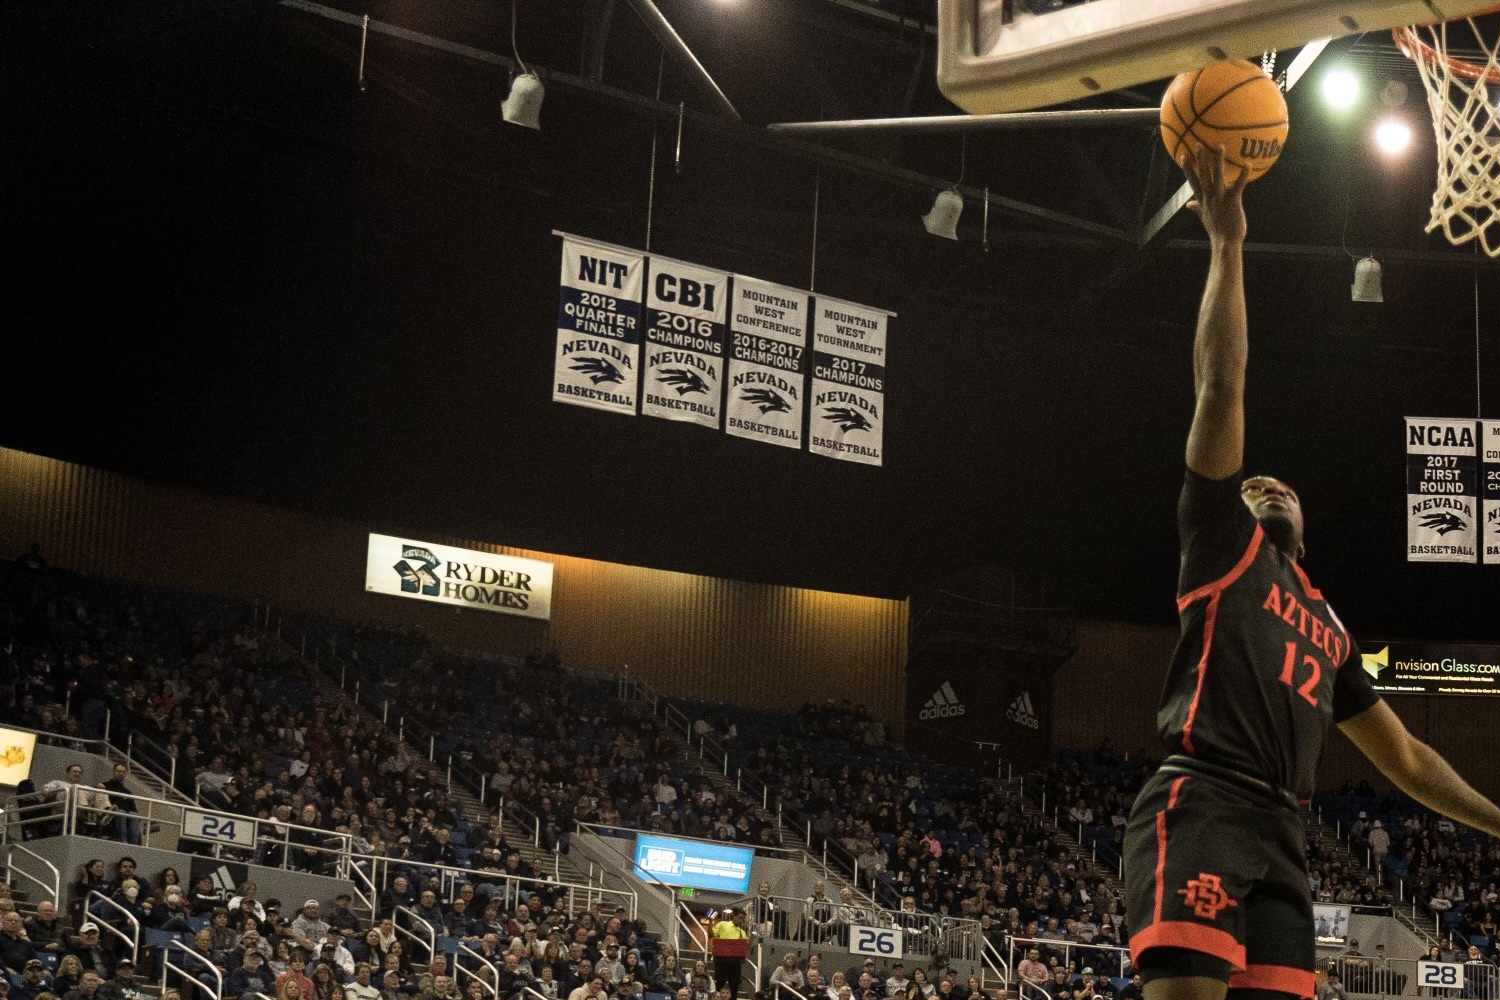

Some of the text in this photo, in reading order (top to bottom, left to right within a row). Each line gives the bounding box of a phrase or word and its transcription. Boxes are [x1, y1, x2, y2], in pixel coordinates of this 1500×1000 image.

[578, 255, 627, 288] NIT
[580, 293, 617, 310] 2012
[655, 273, 715, 312] CBI
[743, 289, 798, 310] MOUNTAIN
[564, 303, 636, 329] QUARTER
[754, 304, 785, 319] WEST
[825, 310, 878, 330] MOUNTAIN
[575, 319, 624, 338] FINALS
[657, 312, 712, 336] 2016
[736, 314, 801, 336] CONFERENCE
[836, 325, 866, 339] WEST
[648, 328, 721, 354] CHAMPIONS
[734, 334, 803, 359] 2016-2017
[817, 334, 883, 355] TOURNAMENT
[562, 340, 632, 369] NEVADA
[649, 351, 716, 380] NEVADA
[735, 347, 799, 370] CHAMPIONS
[832, 357, 866, 374] 2017
[733, 372, 798, 400] NEVADA
[815, 366, 882, 390] CHAMPIONS
[557, 383, 633, 406] BASKETBALL
[646, 394, 716, 417] BASKETBALL
[815, 391, 878, 419] NEVADA
[729, 418, 798, 440] BASKETBALL
[1409, 426, 1474, 447] NCAA
[812, 437, 879, 458] BASKETBALL
[1427, 456, 1457, 468] 2017
[1424, 469, 1460, 480] FIRST
[1420, 482, 1464, 493] ROUND
[1411, 498, 1472, 518] NEVADA
[1410, 545, 1475, 555] BASKETBALL
[445, 560, 532, 591] RYDER
[444, 582, 529, 610] HOMES
[1263, 583, 1342, 668] AZTECS
[1279, 642, 1321, 707] 12
[919, 704, 965, 720] adidas
[202, 816, 236, 840] 24
[859, 930, 894, 954] 26
[1425, 965, 1456, 985] 28
